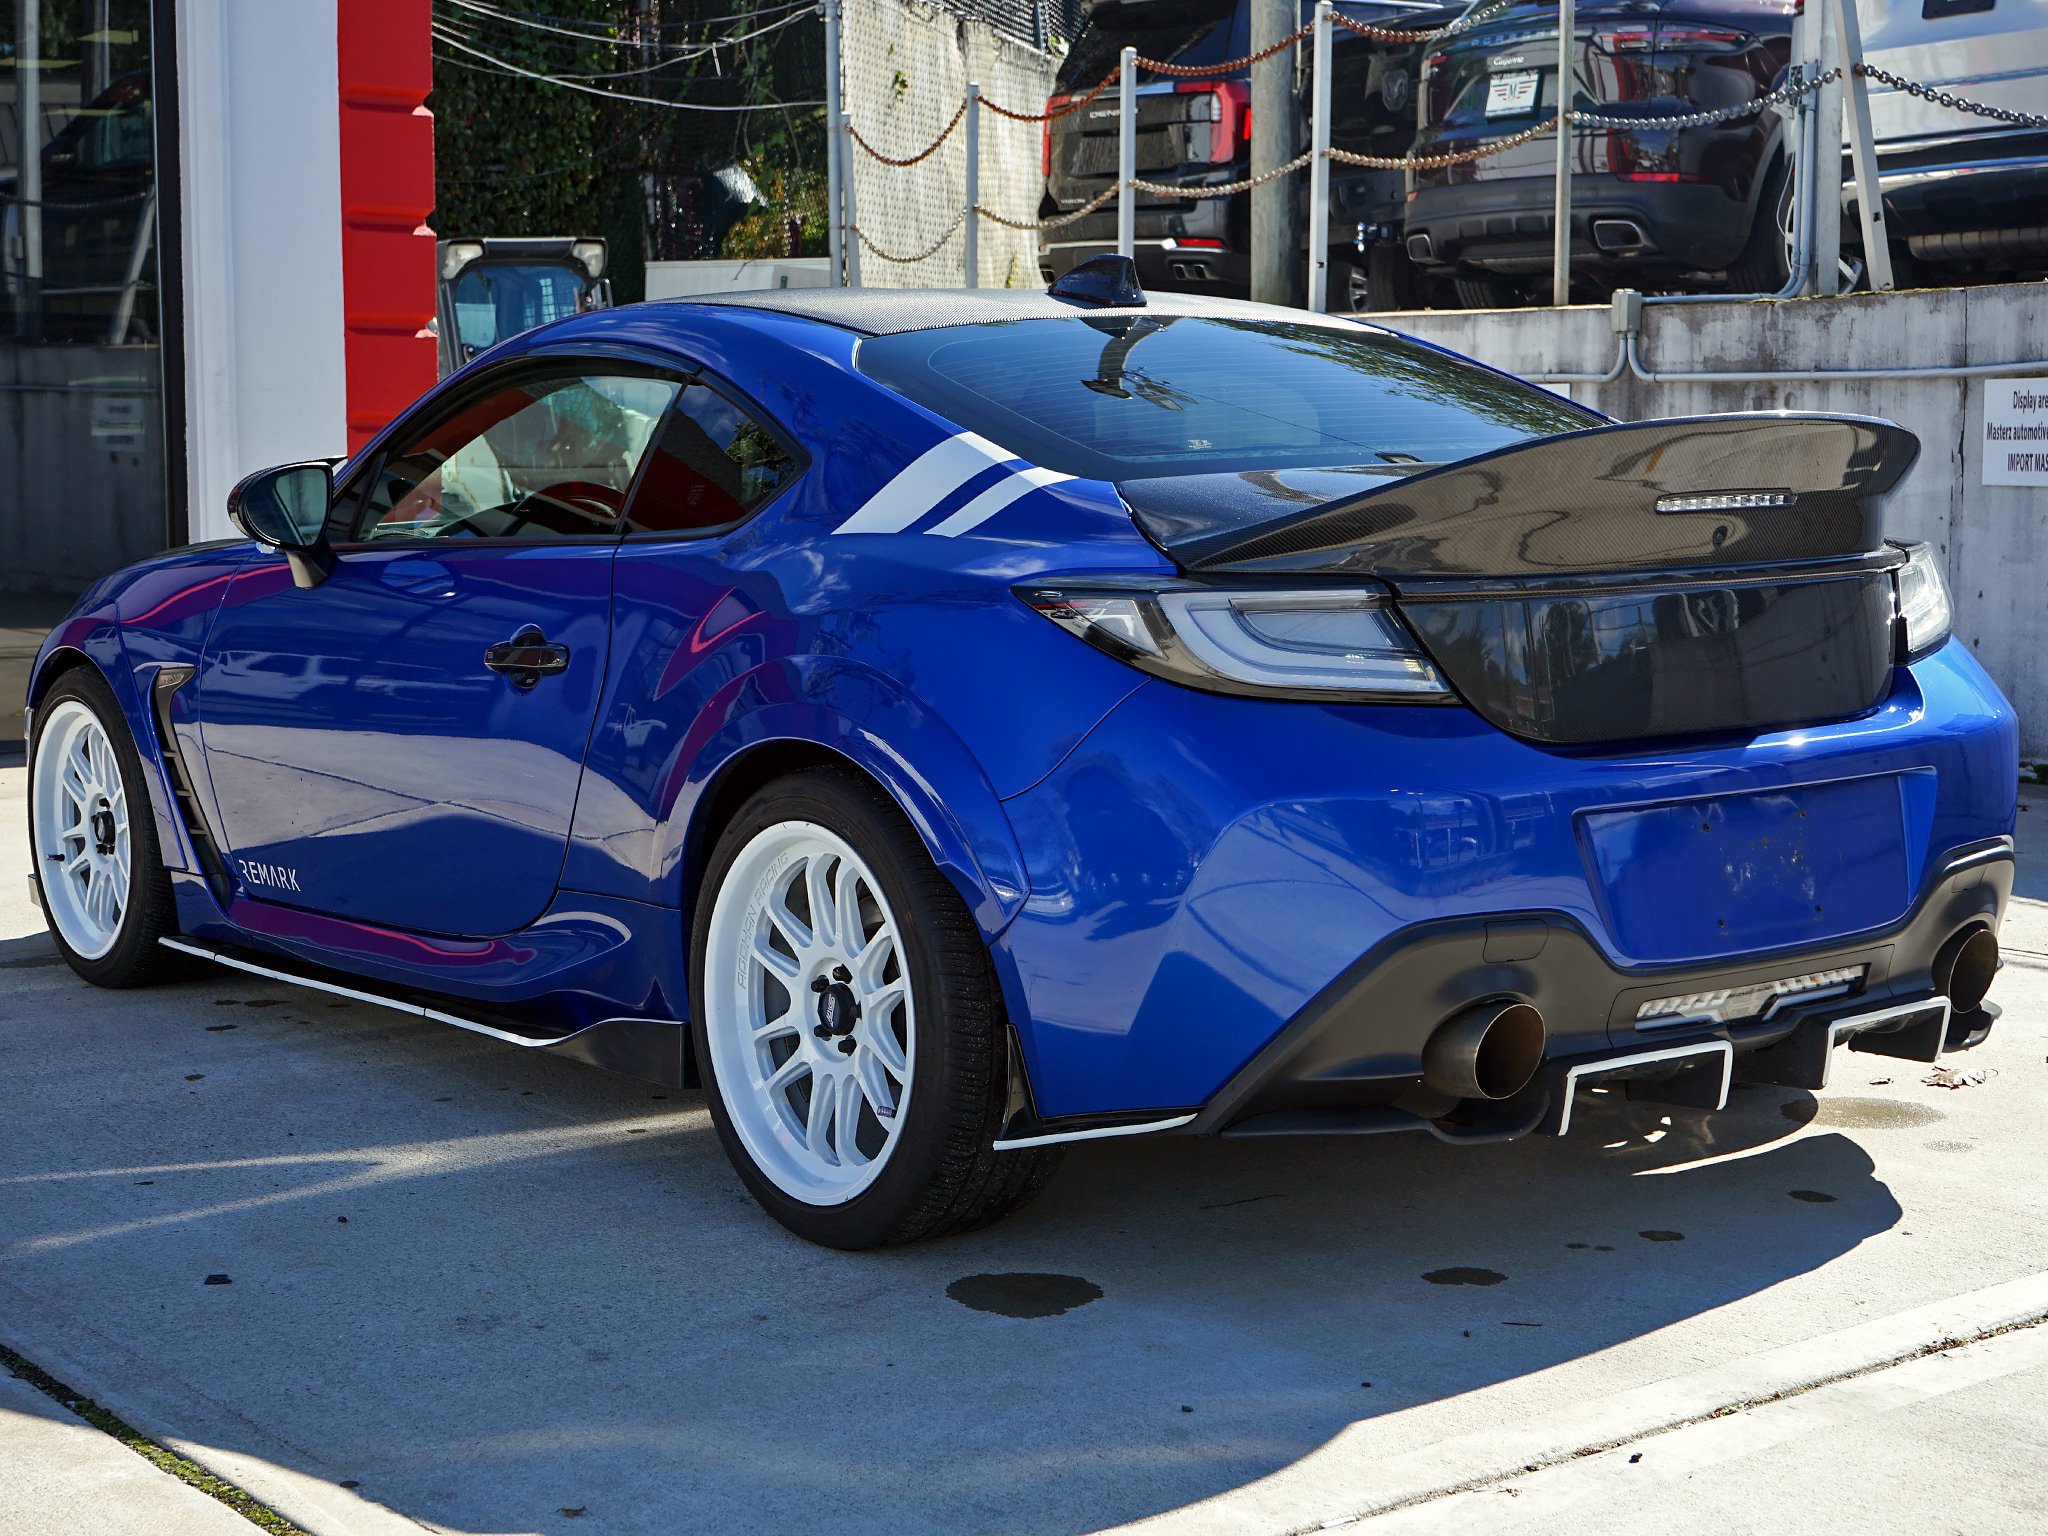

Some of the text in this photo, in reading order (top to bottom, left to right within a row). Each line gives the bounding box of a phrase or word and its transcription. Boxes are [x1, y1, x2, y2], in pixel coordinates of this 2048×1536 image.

[1493, 56, 1525, 66] Cayenne
[2013, 390, 2037, 414] Display
[1986, 421, 2012, 441] Masterz
[2007, 453, 2034, 472] IMPORT
[239, 859, 302, 892] REMARK
[754, 852, 788, 906] RACING
